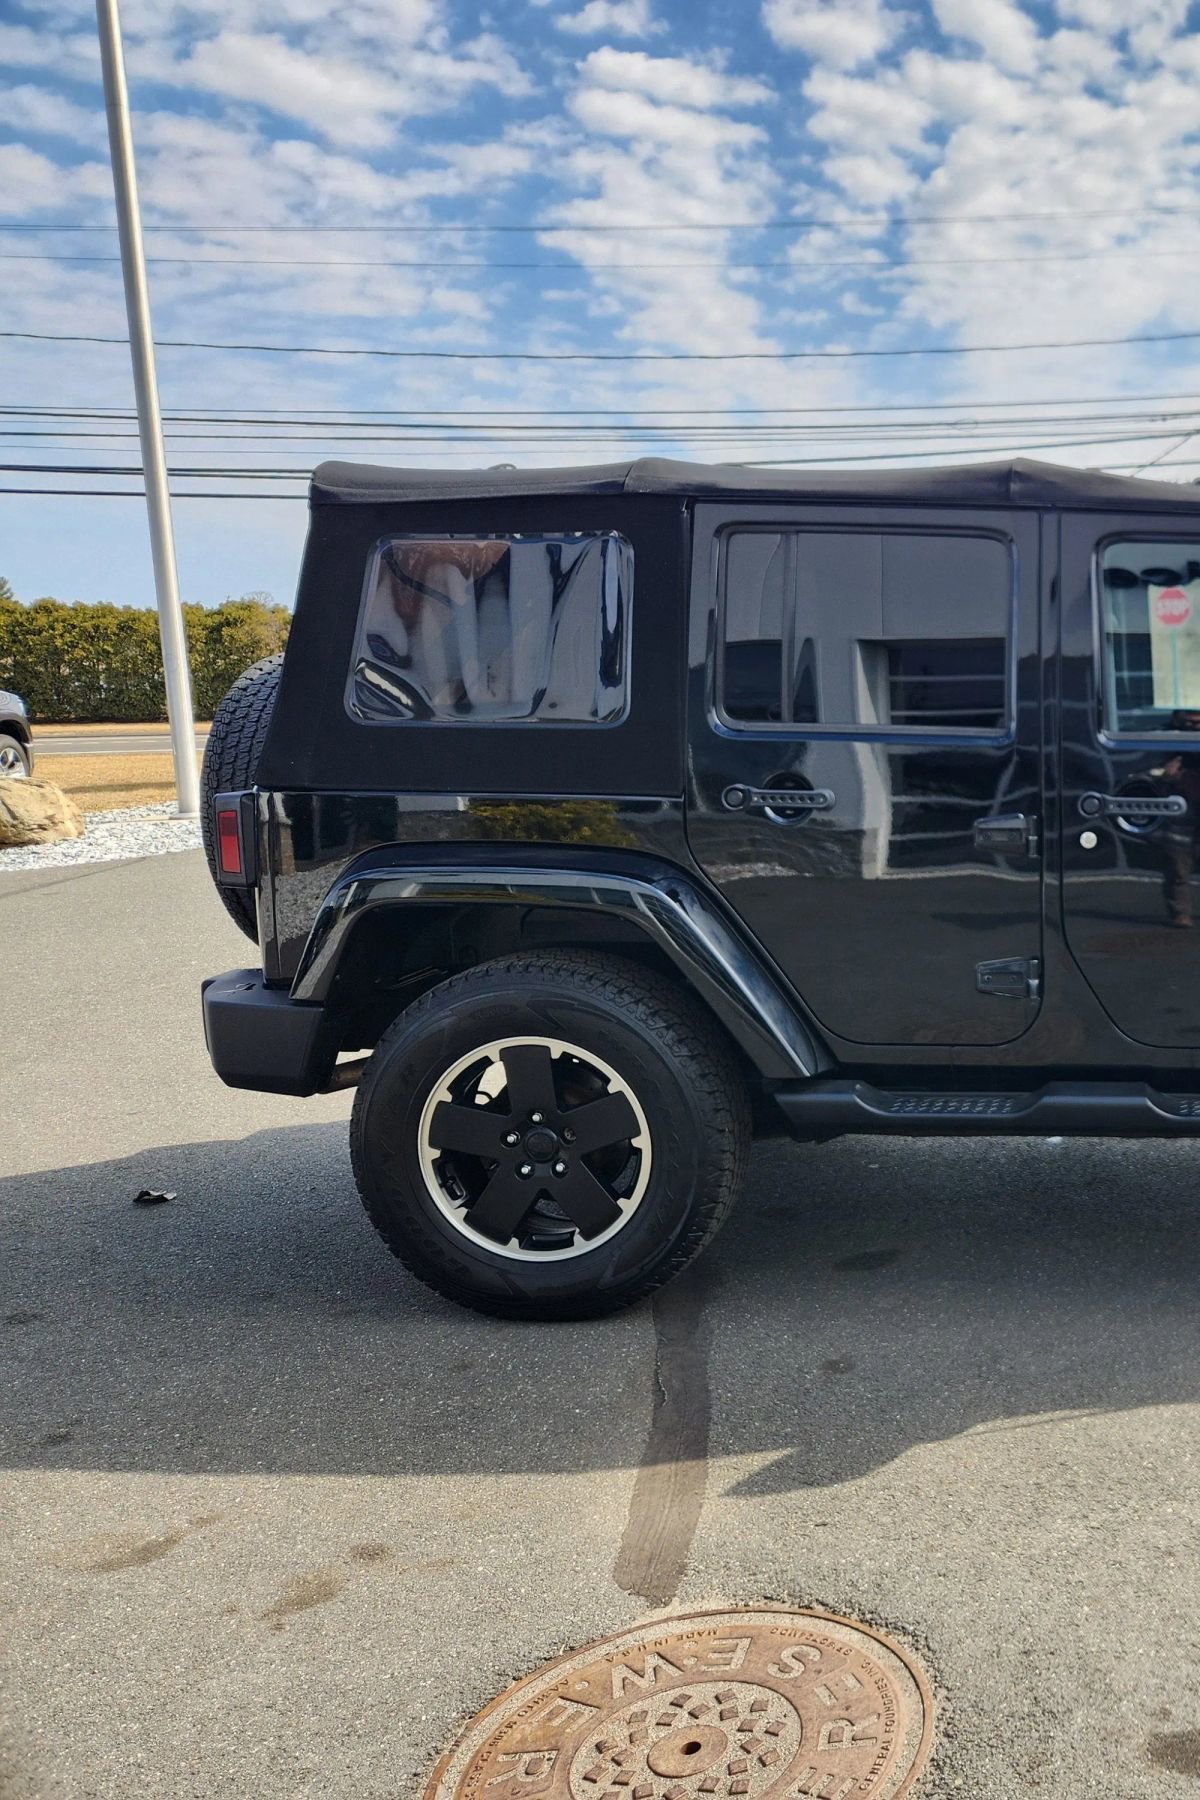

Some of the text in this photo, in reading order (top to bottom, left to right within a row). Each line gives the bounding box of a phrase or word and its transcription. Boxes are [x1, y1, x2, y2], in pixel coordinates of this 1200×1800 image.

[1153, 599, 1190, 615] STOP
[654, 1638, 669, 1647] IN
[676, 1628, 719, 1640] MADE
[484, 1636, 823, 1788] SEWER
[874, 1677, 896, 1734] FOUNDRIES
[858, 1737, 894, 1791] GENERAL
